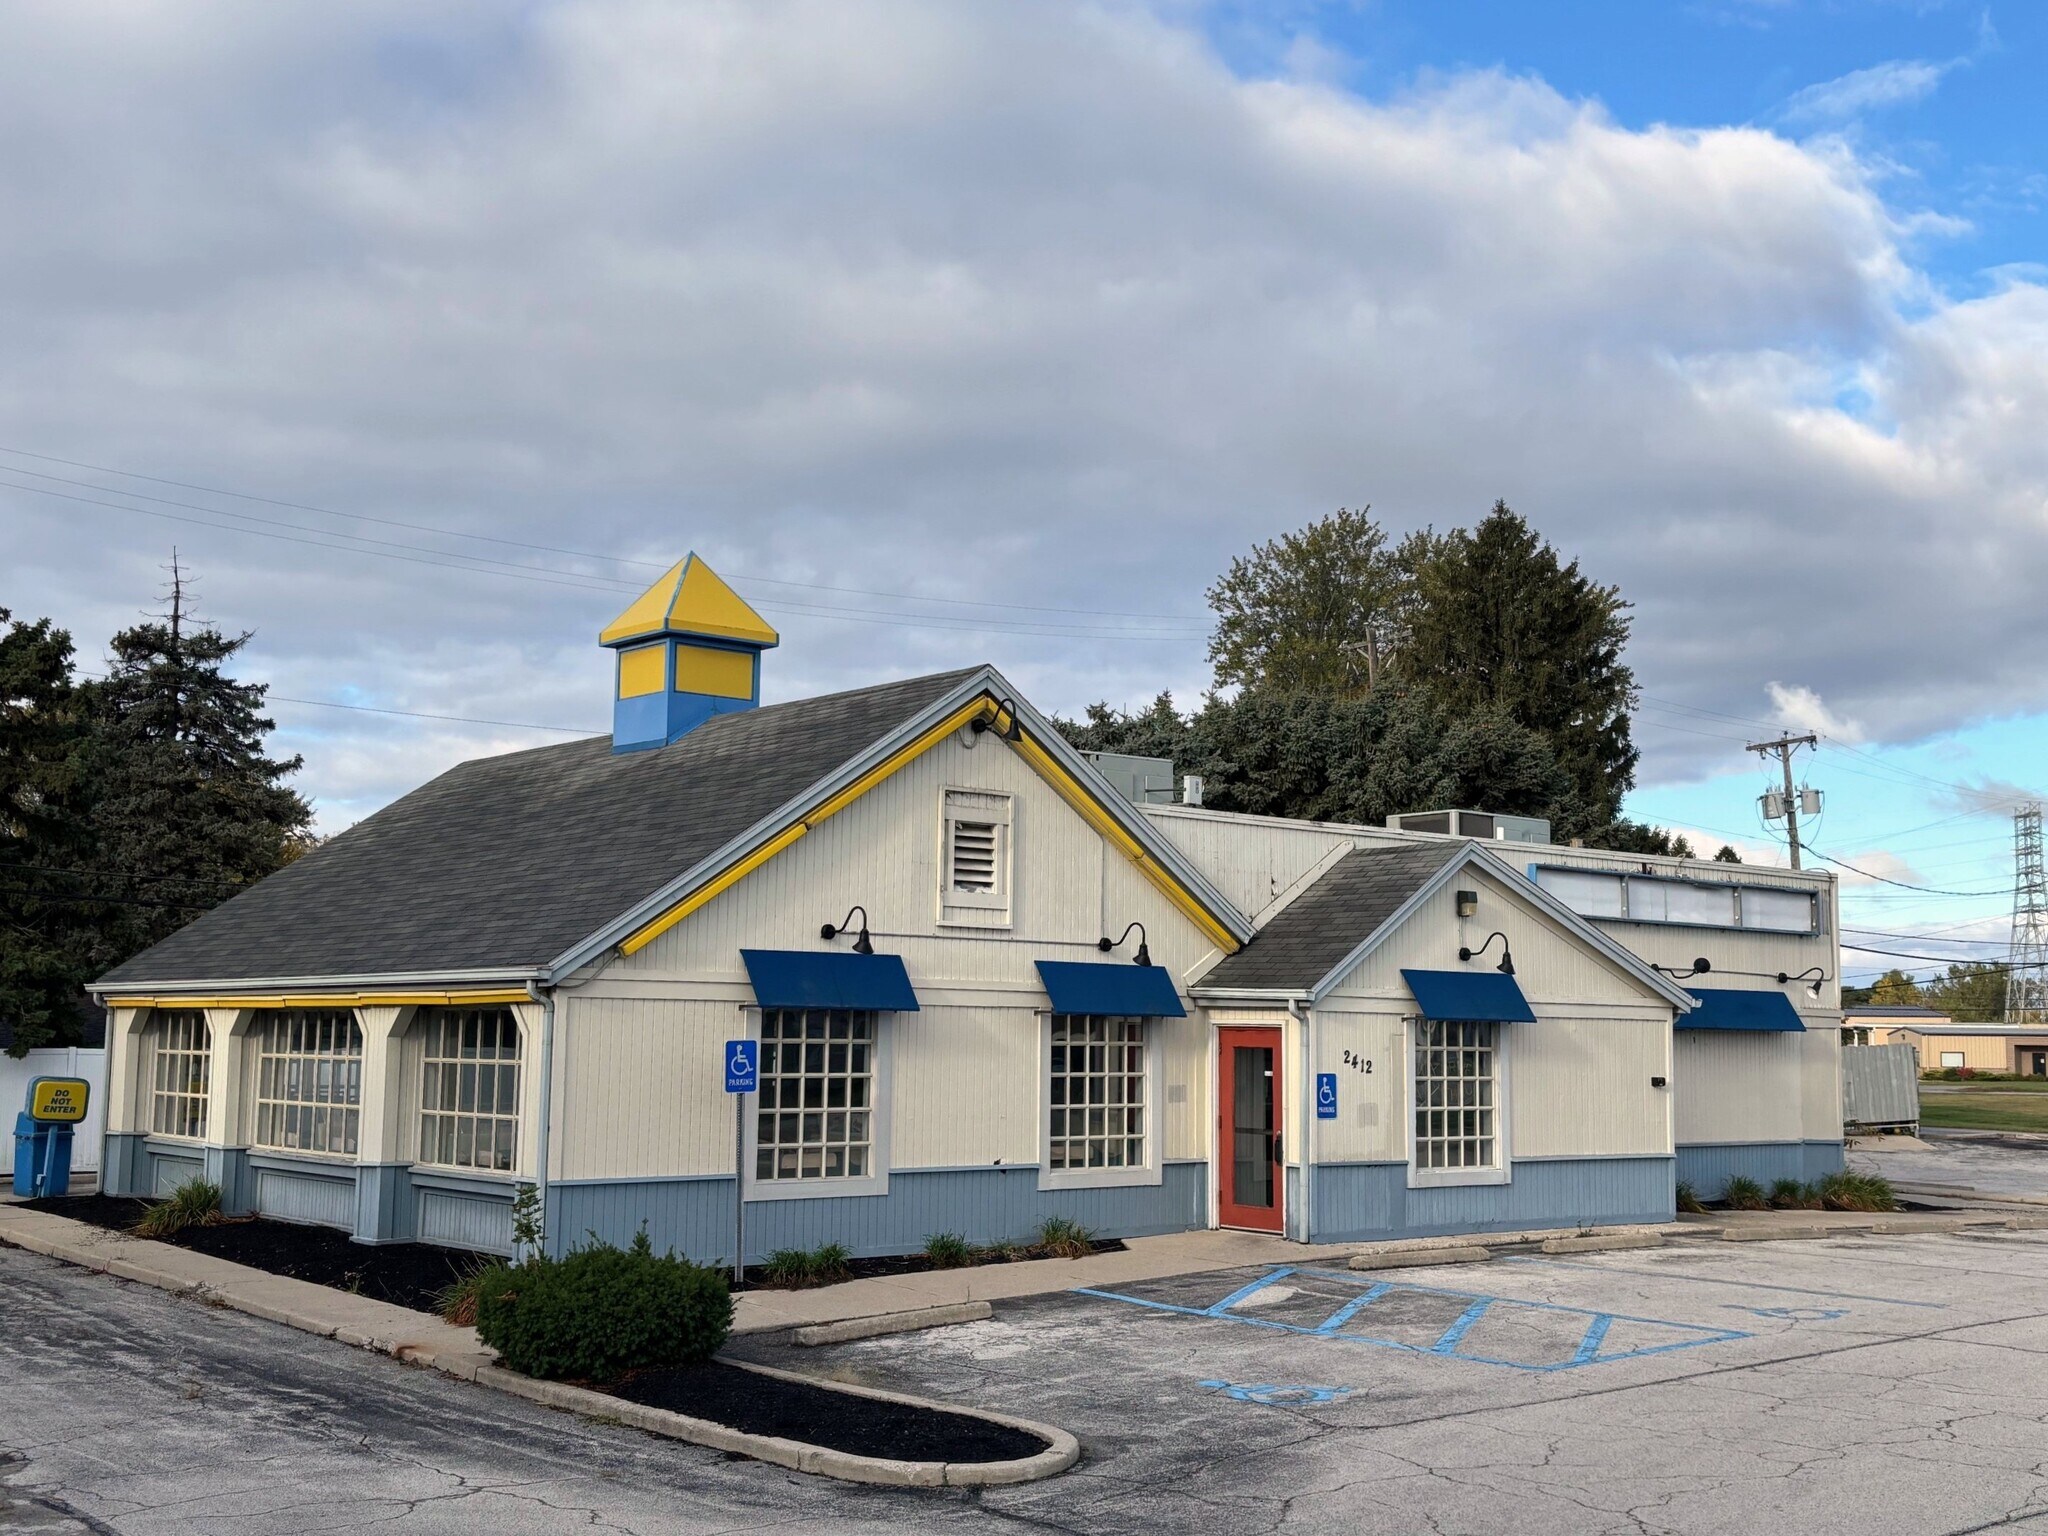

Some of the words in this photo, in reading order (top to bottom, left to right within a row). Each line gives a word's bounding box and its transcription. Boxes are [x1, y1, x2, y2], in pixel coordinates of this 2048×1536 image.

[1343, 1050, 1372, 1074] 2412
[728, 1078, 753, 1086] PARKING
[54, 1089, 70, 1097] DO
[50, 1097, 72, 1105] NOT
[43, 1105, 76, 1113] ENTER
